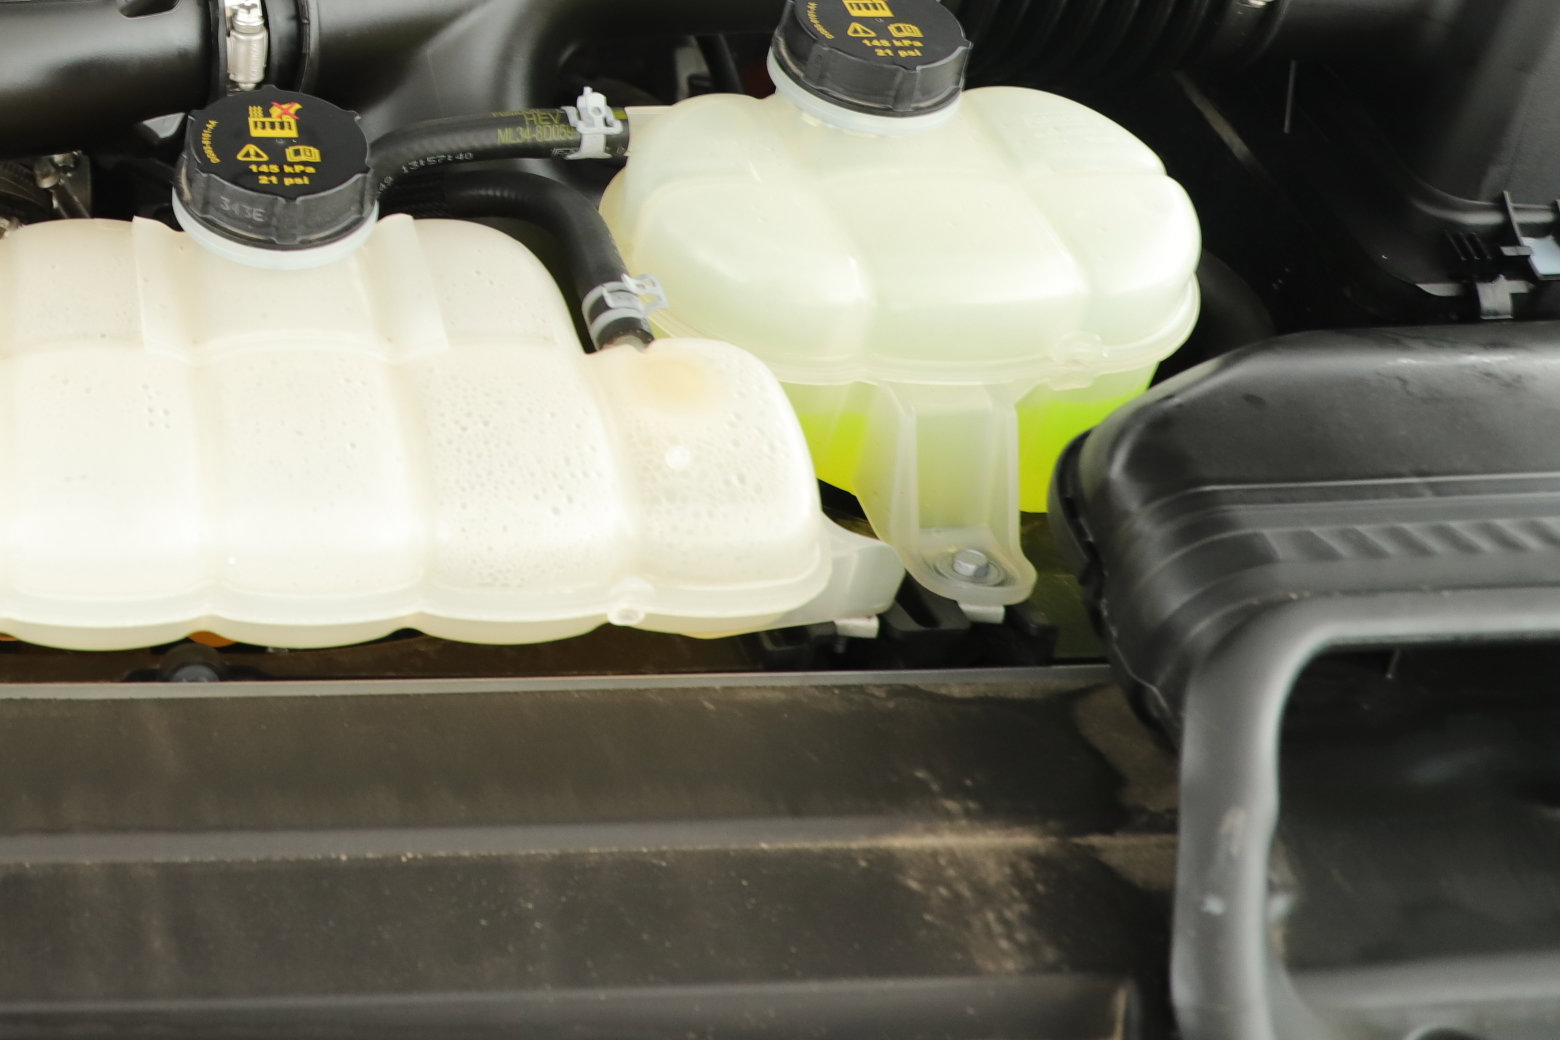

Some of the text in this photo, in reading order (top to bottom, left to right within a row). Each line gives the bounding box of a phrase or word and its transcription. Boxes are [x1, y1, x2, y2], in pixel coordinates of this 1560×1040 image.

[892, 39, 924, 47] kPa
[874, 48, 923, 58] 21 psi
[249, 164, 316, 174] 145 kPa
[258, 175, 310, 187] 21 psi
